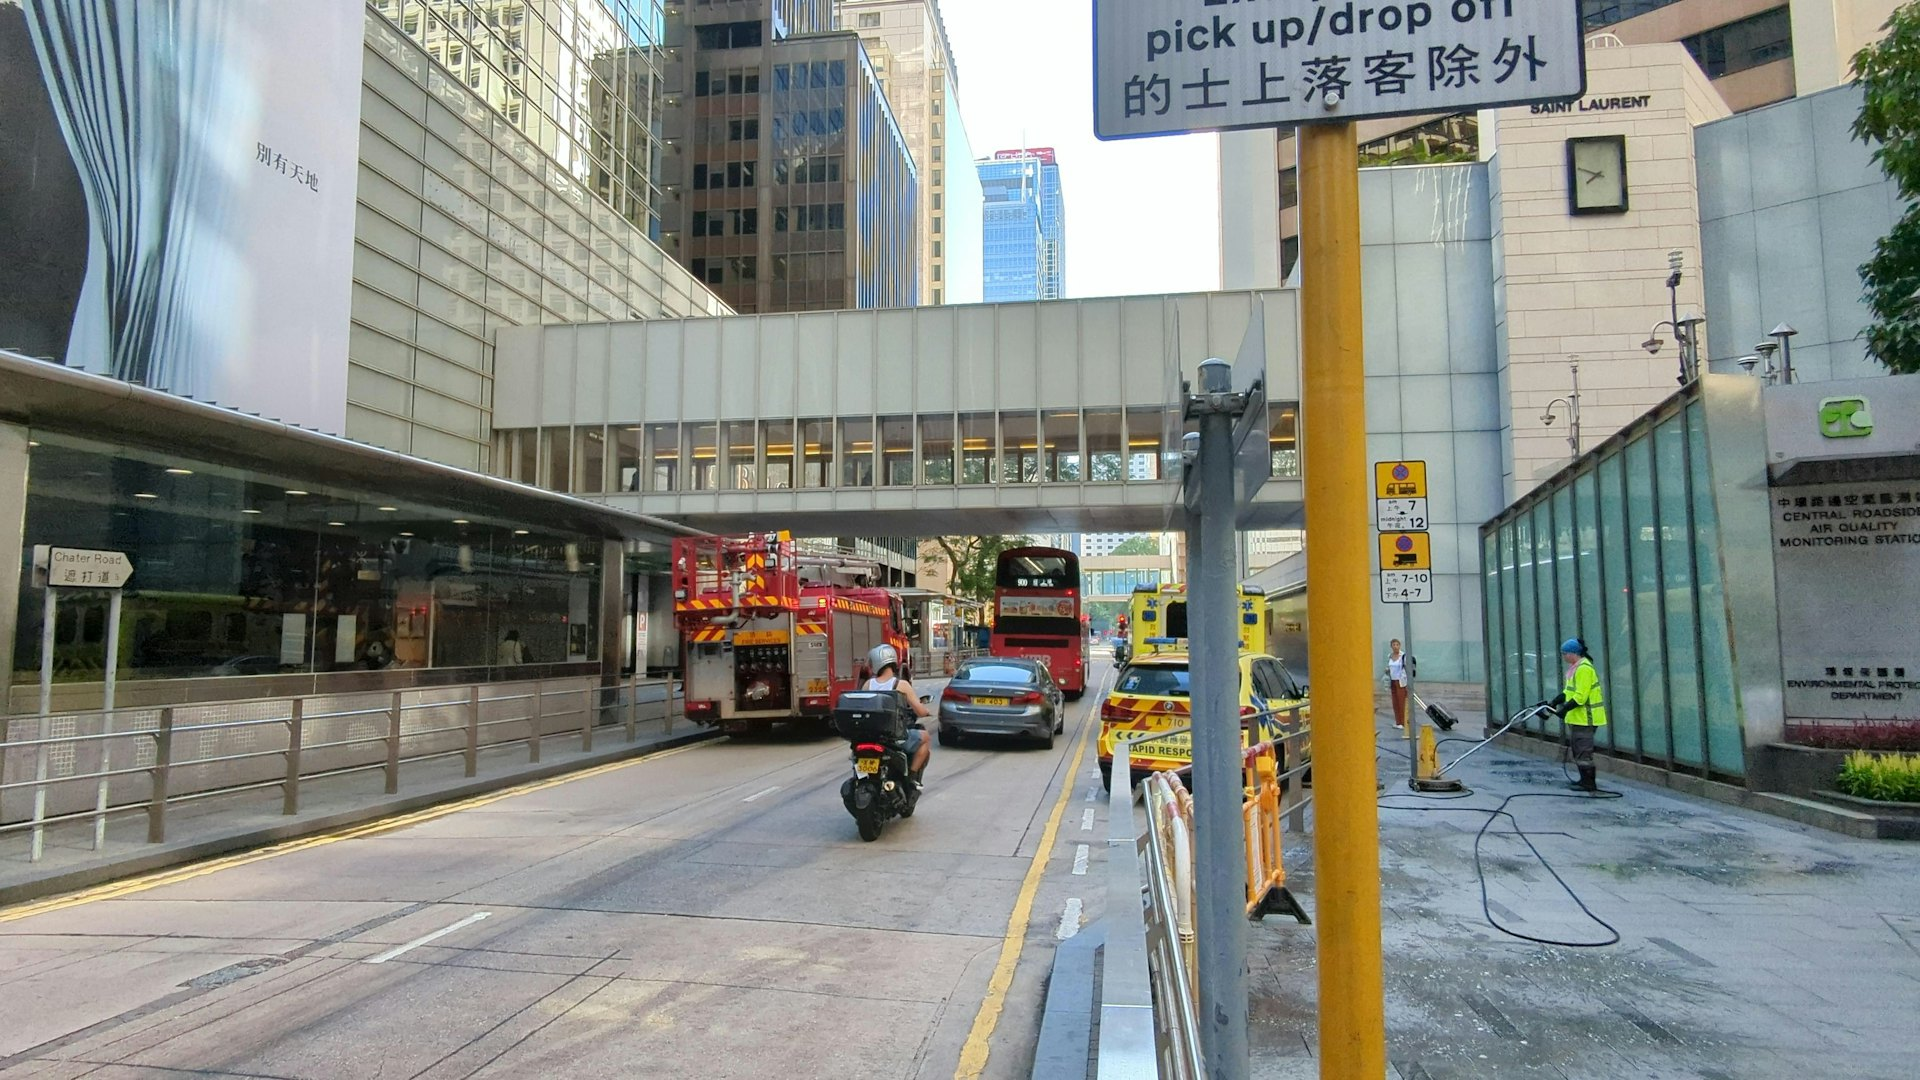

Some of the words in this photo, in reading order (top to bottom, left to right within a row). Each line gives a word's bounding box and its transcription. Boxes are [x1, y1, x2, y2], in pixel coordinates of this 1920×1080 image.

[1147, 15, 1236, 61] pick
[1253, 1, 1431, 49] up/drop
[1123, 34, 1548, 118] 的士上落客除外
[1530, 102, 1574, 114] SAINT
[1579, 95, 1651, 112] LAURENT
[256, 141, 319, 193] 別有天地
[1408, 500, 1416, 511] 7
[1783, 511, 1847, 522] CENTRAL
[1409, 517, 1424, 528] 12
[1810, 523, 1833, 533] AIR
[1839, 521, 1898, 533] QUALITY
[1780, 535, 1868, 547] MONITORING
[54, 551, 91, 564] Chater
[94, 553, 122, 565] Road
[1401, 573, 1428, 583] 7-10
[1401, 588, 1422, 598] 4-7
[1787, 680, 1875, 689] ENVIRONMENTAL
[1831, 692, 1903, 700] DEPARTMENT
[1156, 717, 1162, 726] A
[1168, 718, 1184, 727] 710
